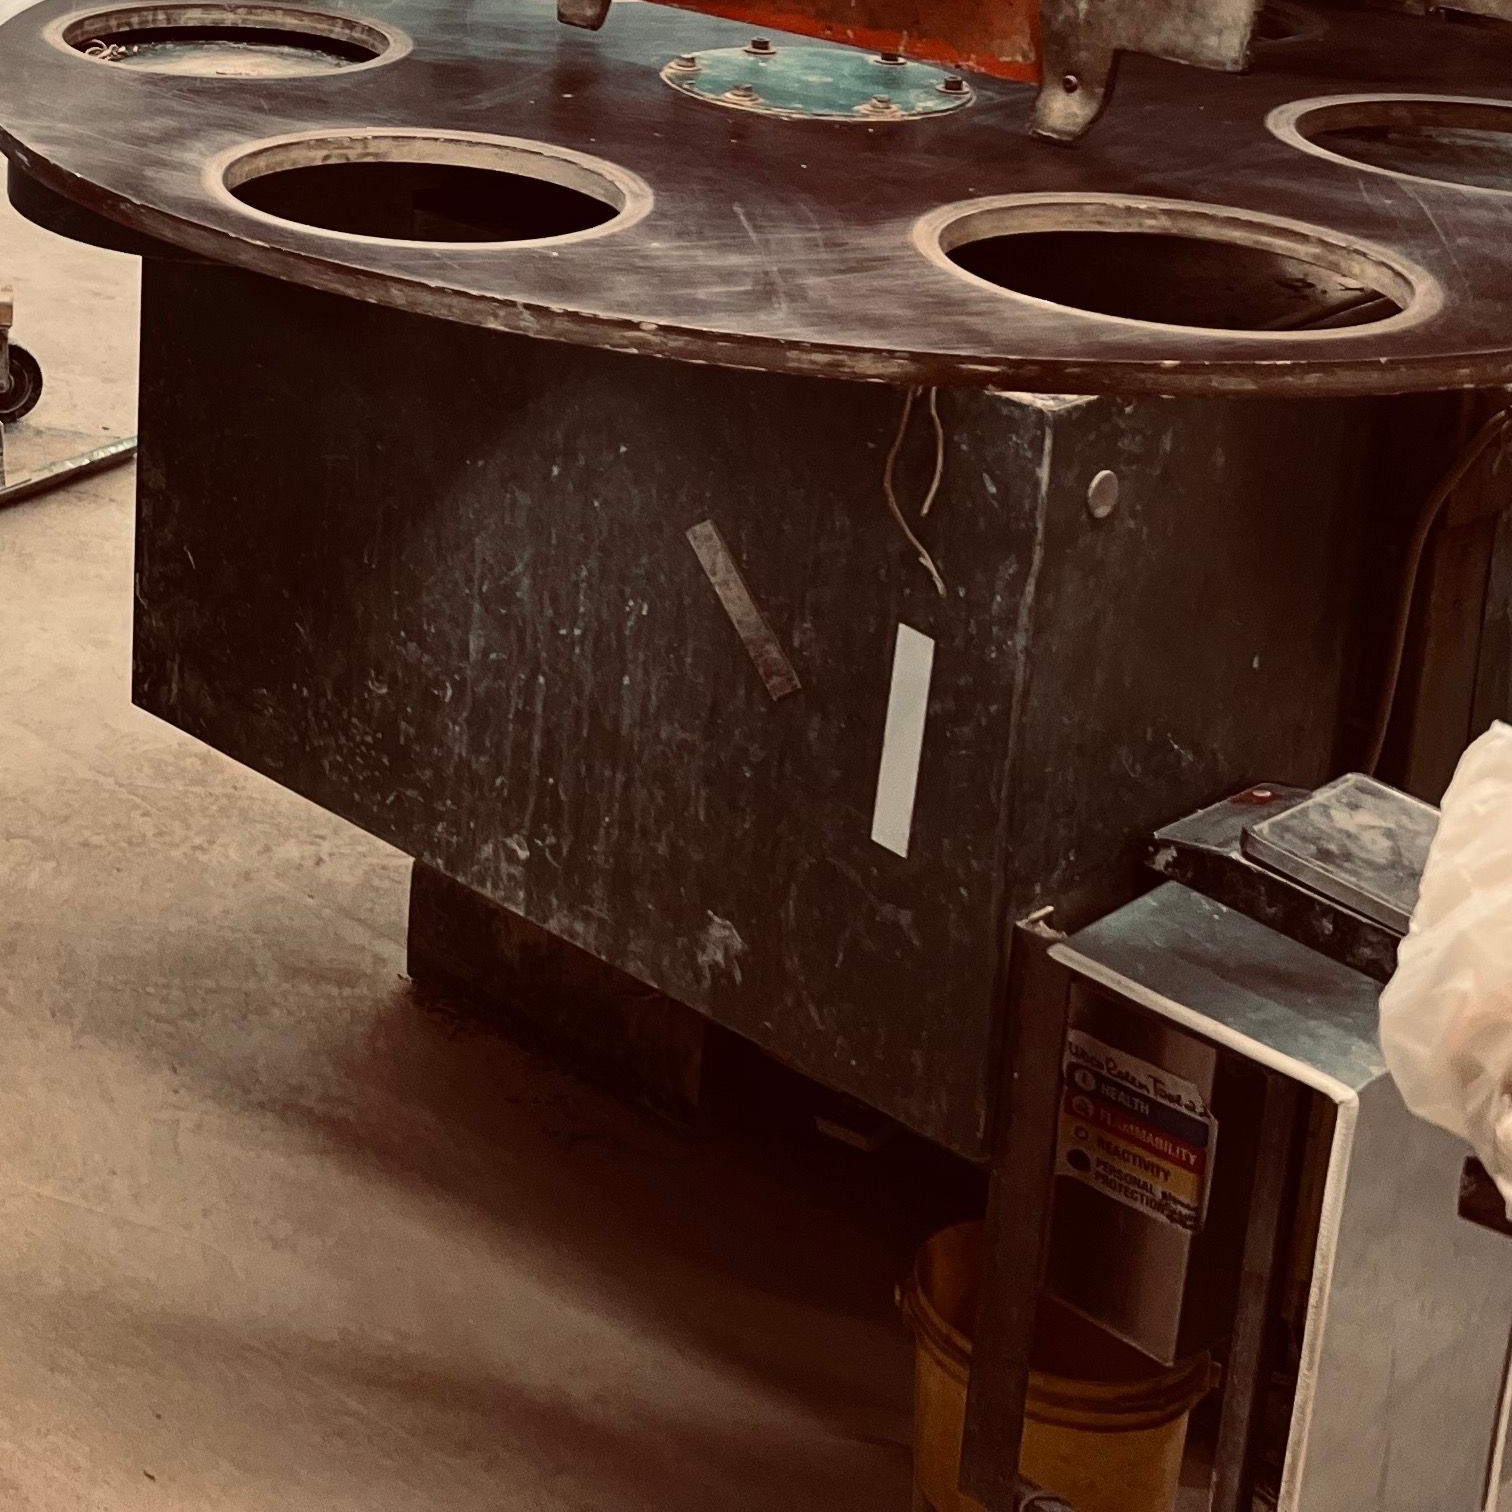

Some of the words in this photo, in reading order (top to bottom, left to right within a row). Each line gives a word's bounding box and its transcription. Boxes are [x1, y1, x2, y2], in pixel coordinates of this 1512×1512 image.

[1101, 1079, 1150, 1116] HEALTH
[1099, 1109, 1198, 1166] FLAMMABILITY
[1095, 1156, 1156, 1197] PERSONAL
[1096, 1138, 1172, 1182] REACTIVITY
[1094, 1173, 1165, 1215] PROTECTION
